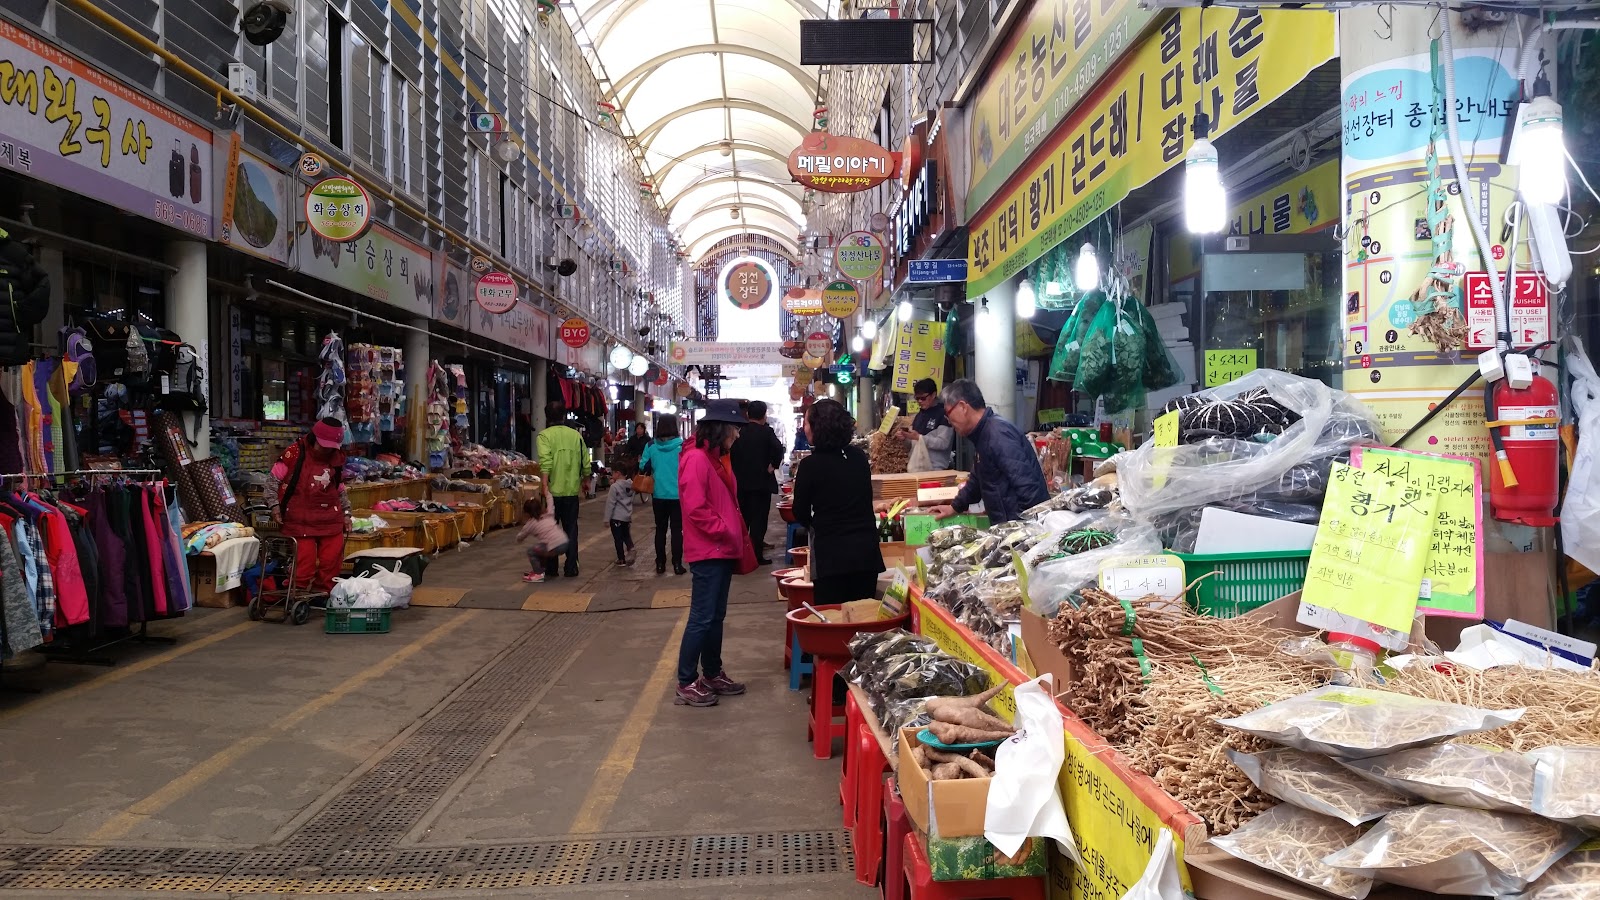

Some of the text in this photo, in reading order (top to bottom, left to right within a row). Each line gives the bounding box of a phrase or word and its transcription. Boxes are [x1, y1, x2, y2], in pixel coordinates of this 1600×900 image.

[1054, 15, 1129, 119] 010-4509-1251
[1343, 97, 1514, 146] 정선장터 종합안내도
[797, 155, 886, 175] 메밀이야기
[312, 202, 364, 218] 화승상회
[849, 234, 871, 248] 365
[345, 239, 409, 285] 화승상회
[738, 271, 759, 285] 정선
[739, 286, 759, 300] 장터
[1473, 280, 1542, 299] 소기
[563, 328, 587, 338] BYC
[896, 322, 914, 389] 산나물전문
[1378, 344, 1407, 352] 관광안내소
[1118, 577, 1167, 593] 고사리
